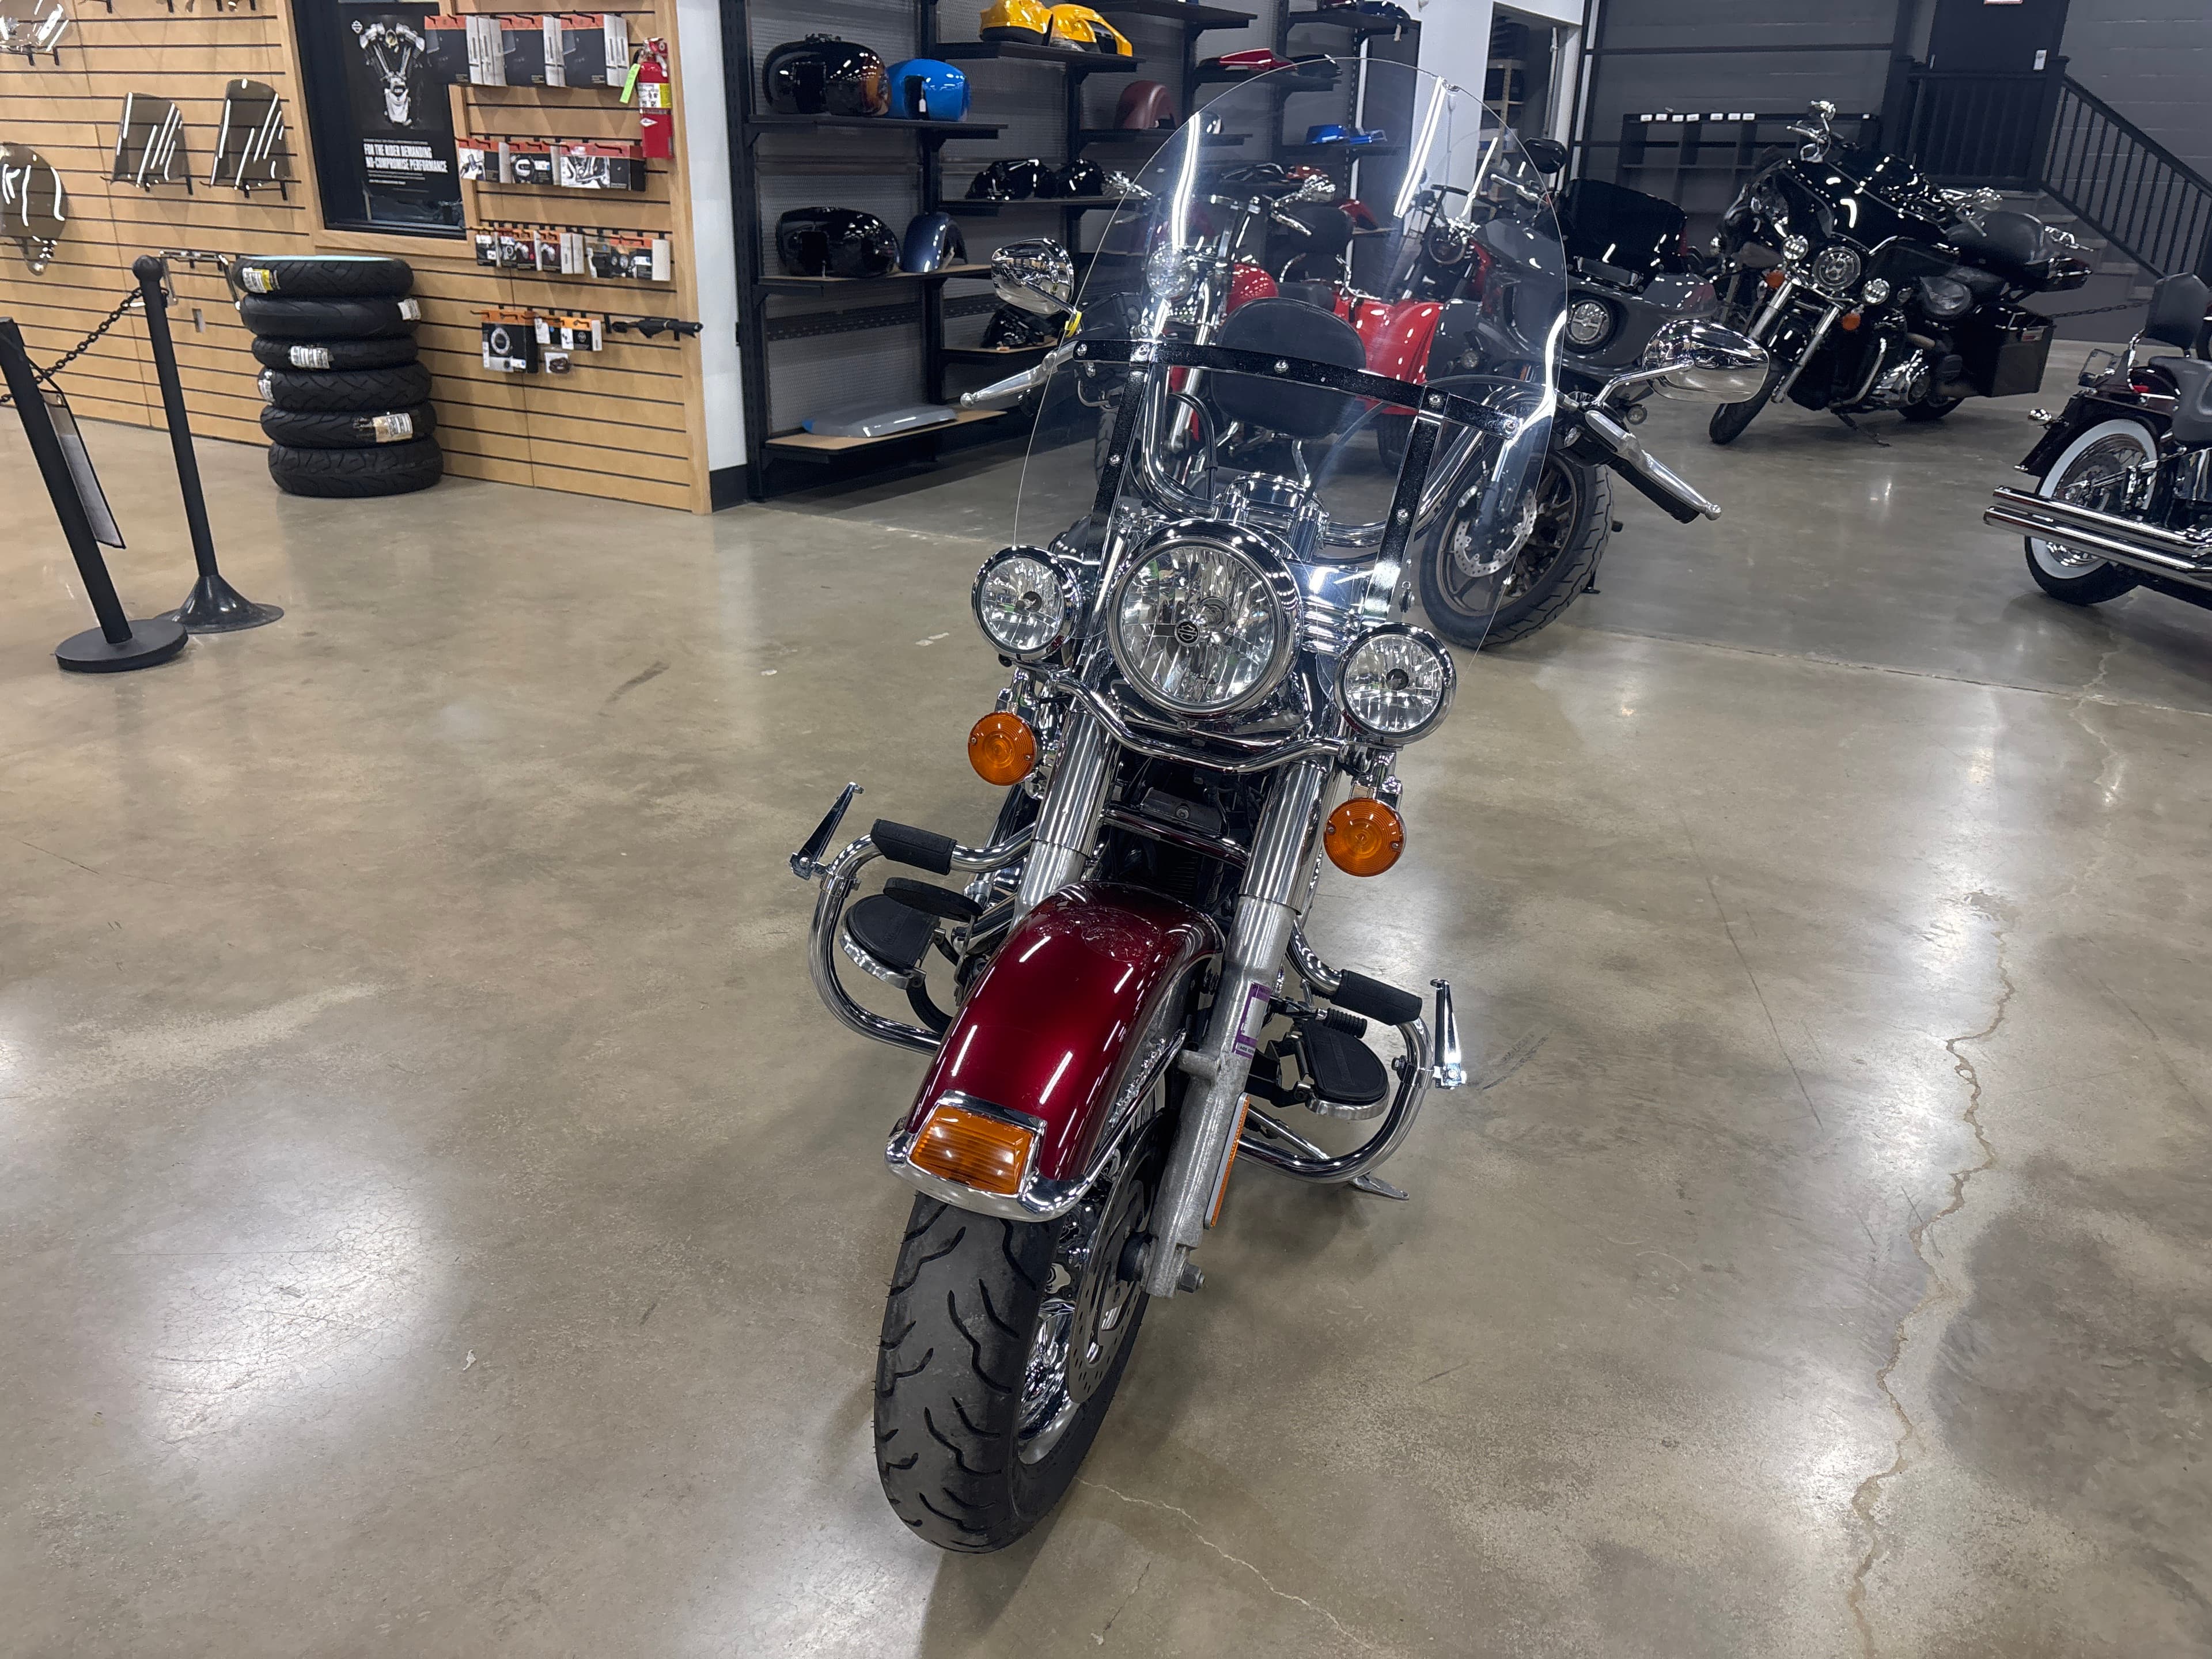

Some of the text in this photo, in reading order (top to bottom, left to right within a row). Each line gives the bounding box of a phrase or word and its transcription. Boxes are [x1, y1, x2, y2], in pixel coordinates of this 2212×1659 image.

[363, 143, 433, 158] FOR THE RIDER DEMANDING
[365, 156, 410, 171] NO-COMPROMISE
[410, 158, 448, 173] PERFORMANCE
